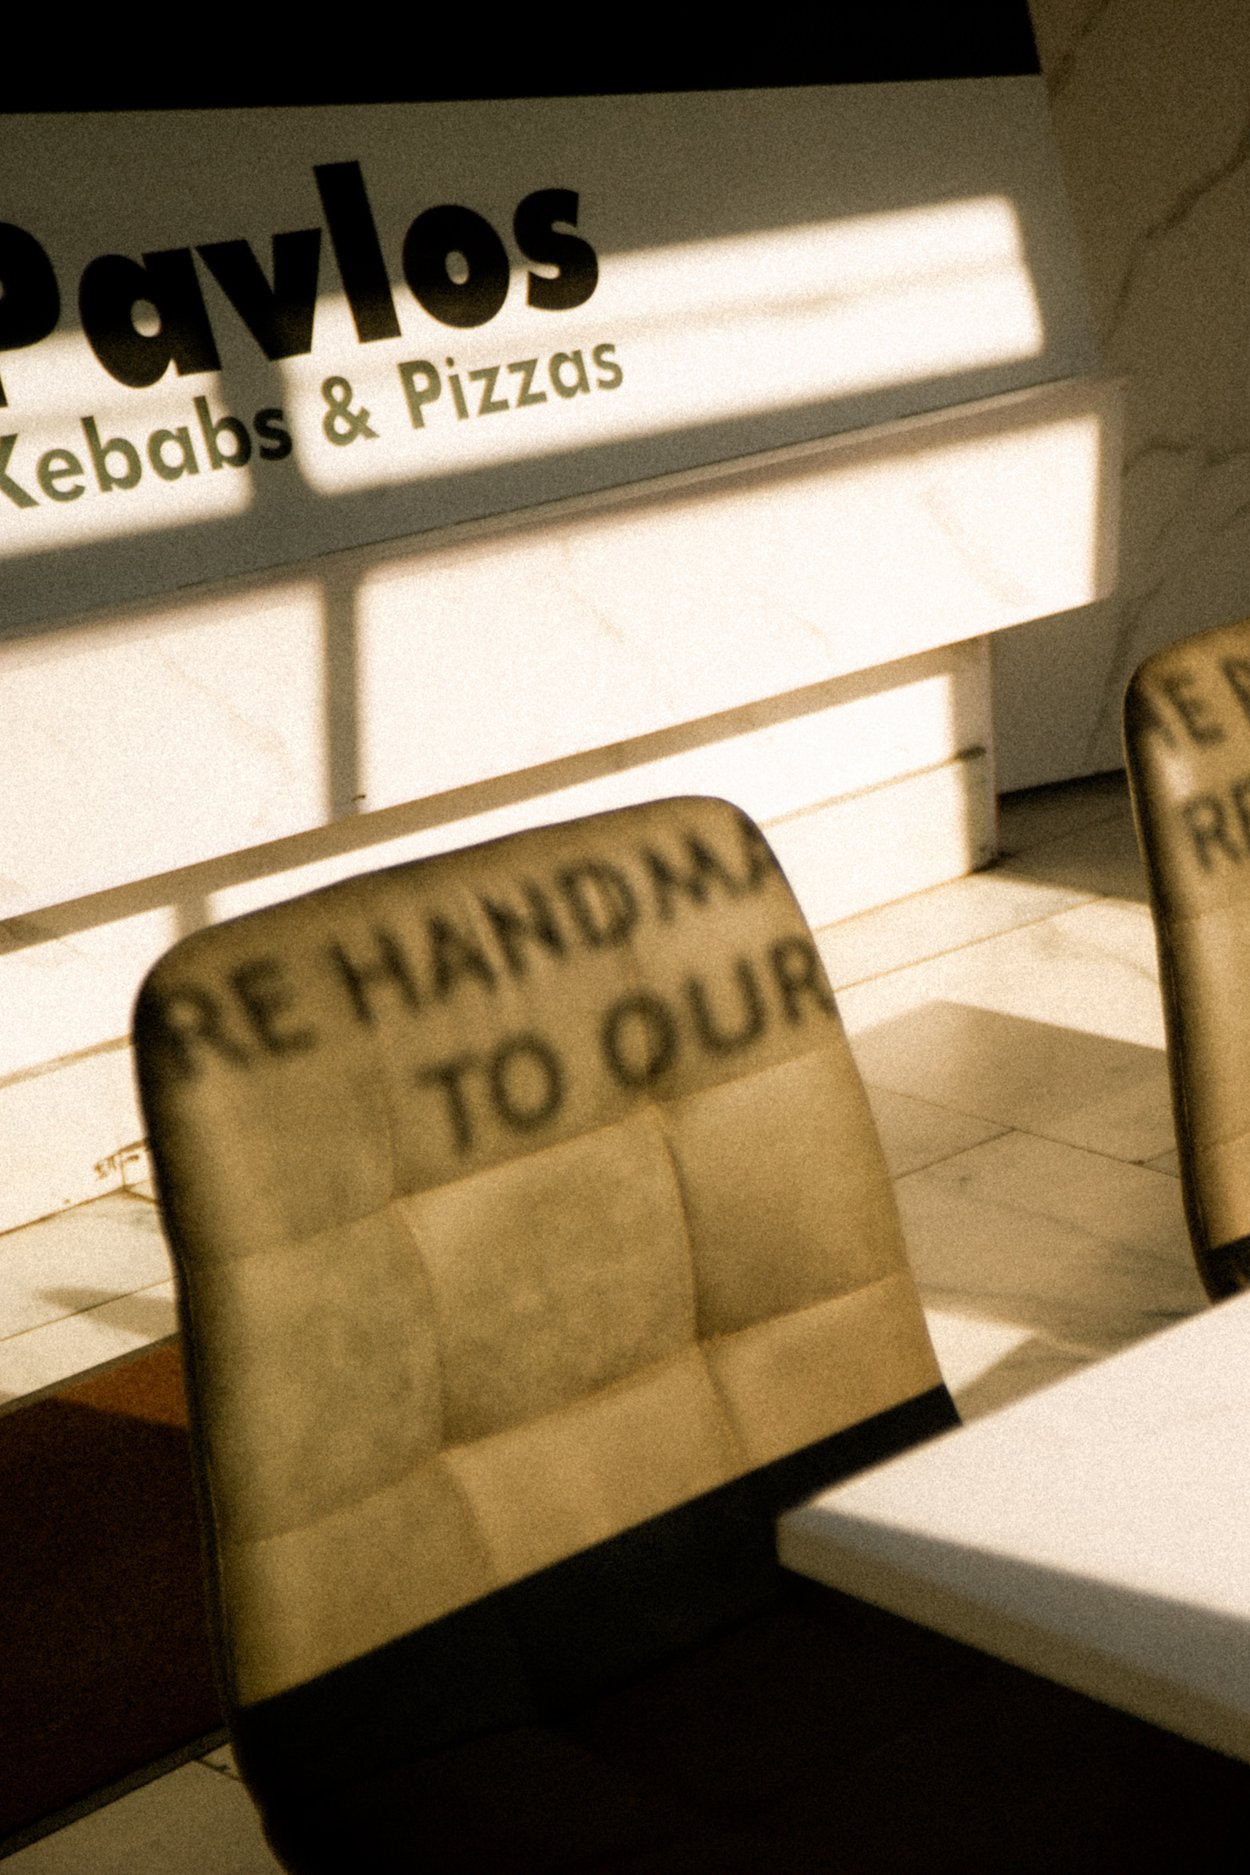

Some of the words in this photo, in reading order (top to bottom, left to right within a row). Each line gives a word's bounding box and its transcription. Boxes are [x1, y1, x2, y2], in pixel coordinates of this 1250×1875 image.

[0, 160, 599, 408] Pavlos
[0, 396, 293, 509] Kebabs
[319, 375, 379, 448] &
[398, 343, 624, 430] Pizzas
[416, 1030, 565, 1156] TO
[602, 934, 840, 1092] OUR
